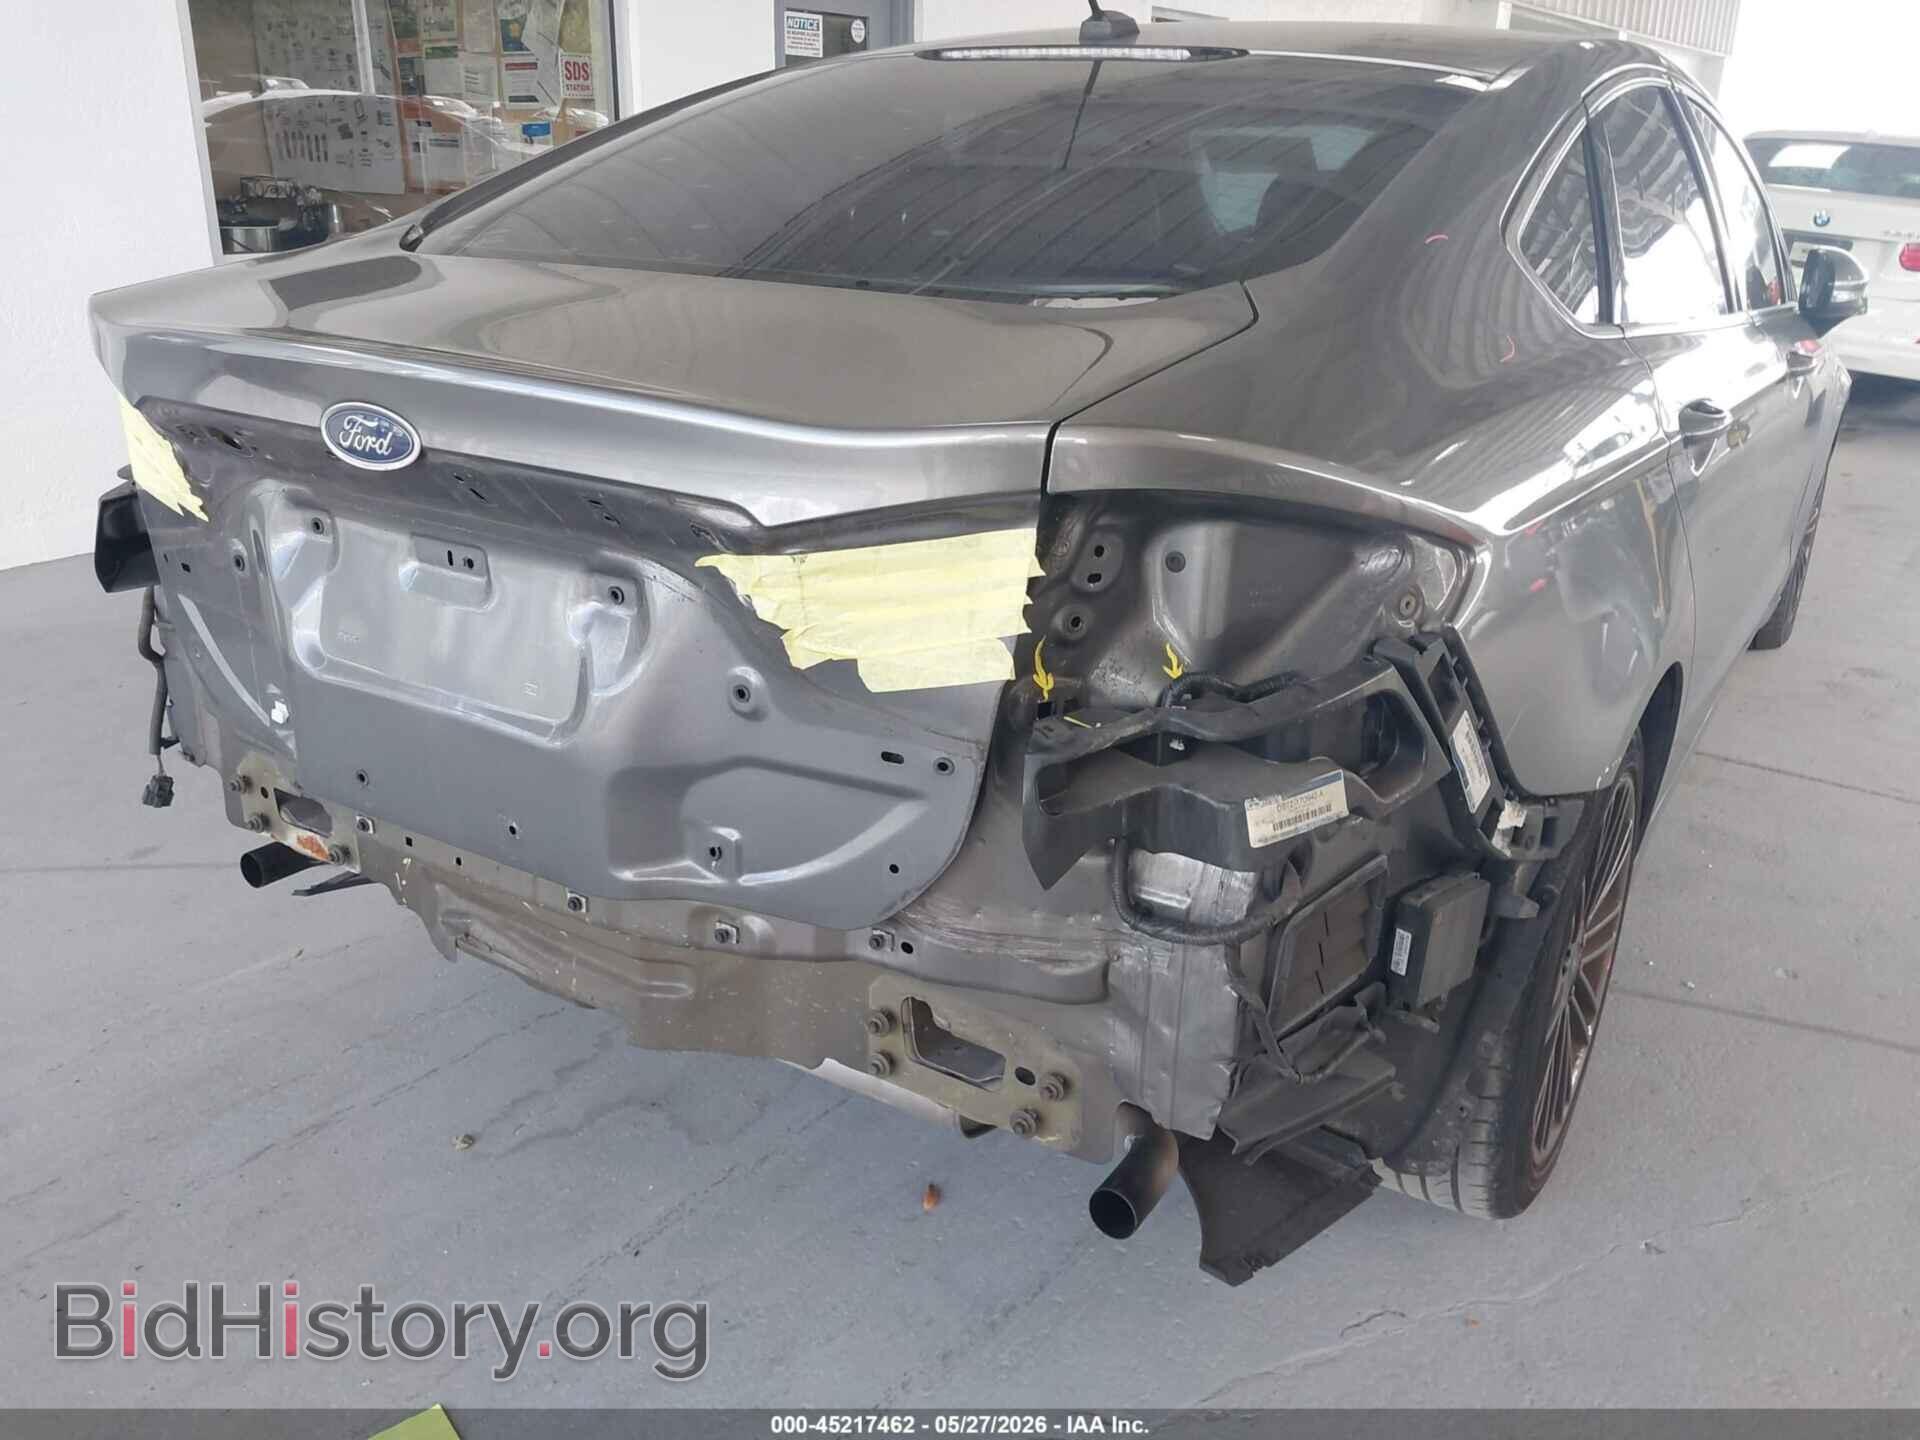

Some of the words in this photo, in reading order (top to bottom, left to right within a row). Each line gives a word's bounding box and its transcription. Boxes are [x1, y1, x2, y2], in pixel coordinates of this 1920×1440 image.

[787, 17, 818, 30] NOTICE
[564, 60, 590, 81] SDS
[339, 415, 393, 456] Ford
